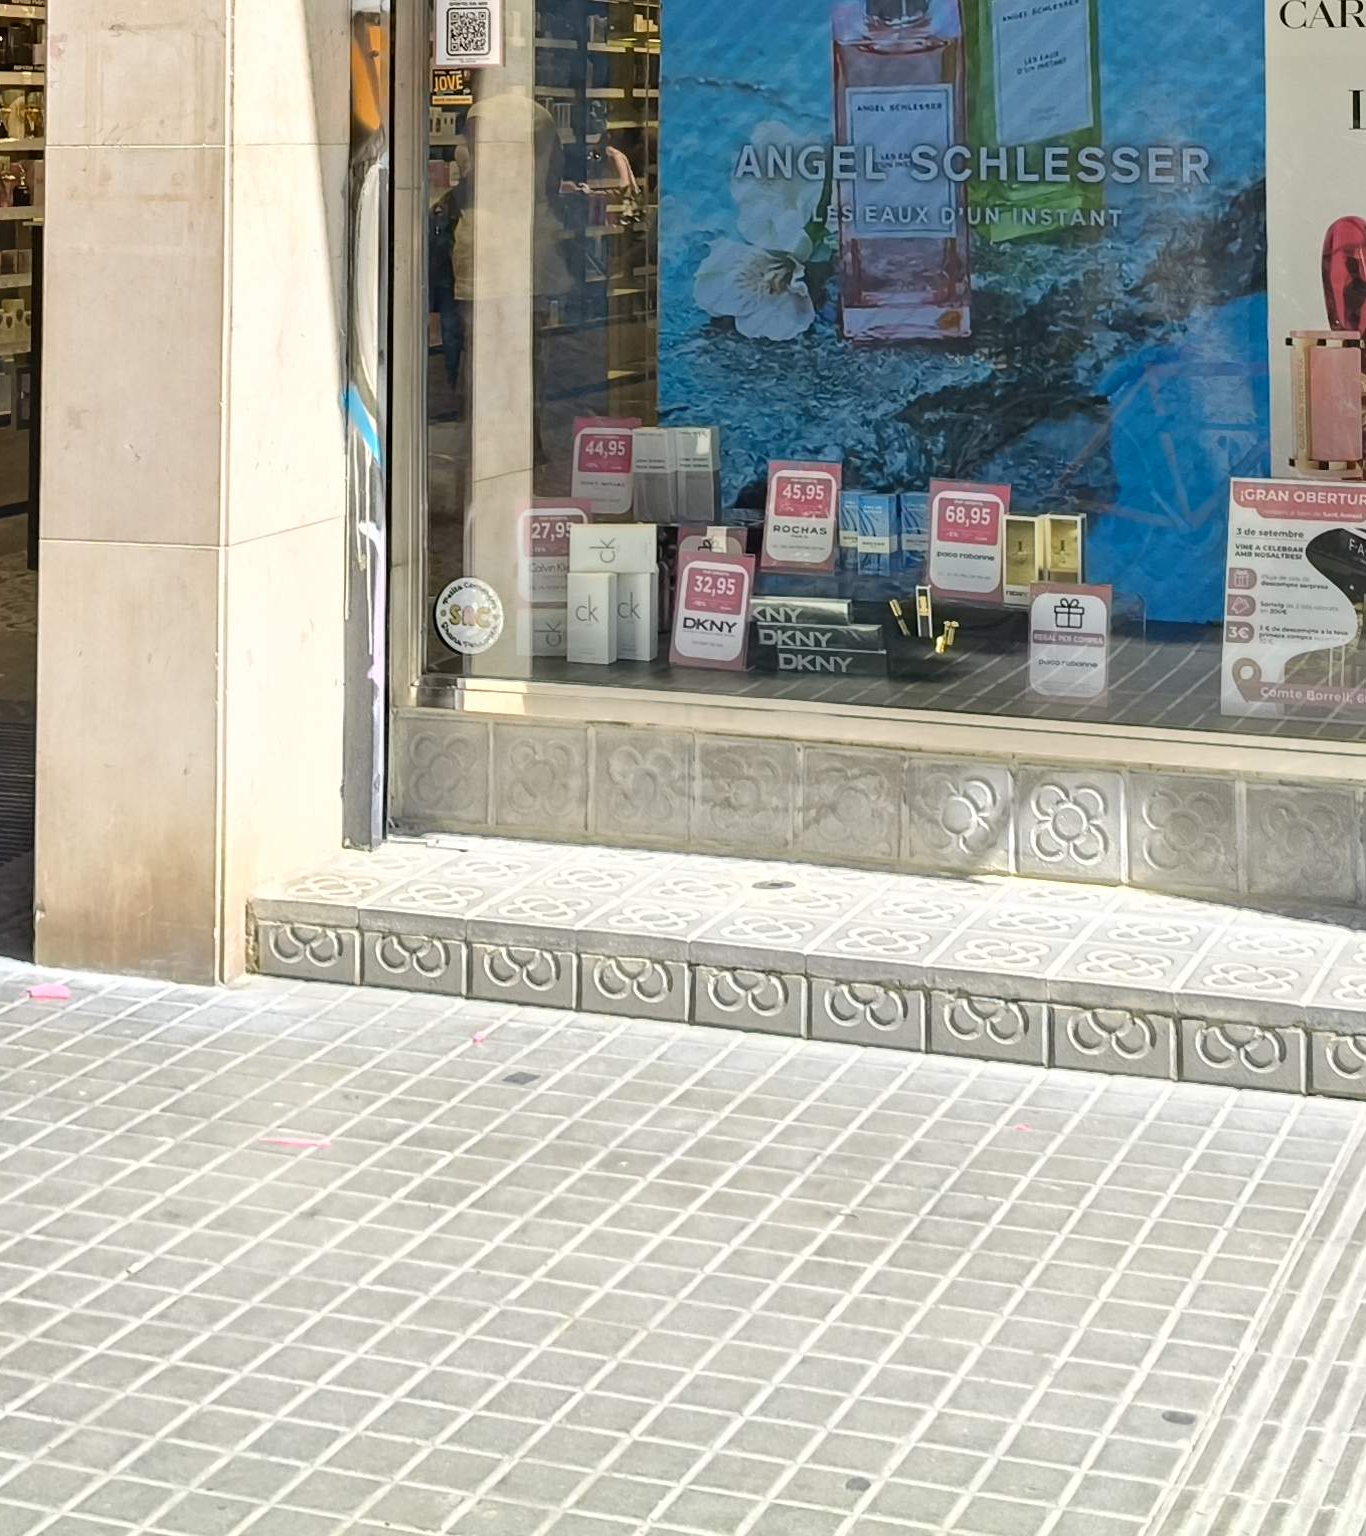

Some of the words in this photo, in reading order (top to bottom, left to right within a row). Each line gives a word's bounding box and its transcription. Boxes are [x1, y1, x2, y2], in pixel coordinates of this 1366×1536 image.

[857, 104, 885, 113] ANGEL
[889, 102, 942, 112] SCHLESSER
[734, 144, 886, 181] ANGEL
[910, 145, 1212, 184] SCHLESSER
[812, 205, 853, 222] LES
[864, 206, 928, 224] EAUX
[940, 207, 1000, 225] D'UN
[1011, 208, 1123, 228] INSTANT
[585, 440, 626, 457] 44,95
[783, 484, 825, 501] 45,95
[1240, 488, 1289, 502] ¡GRAN
[945, 505, 991, 527] 68,95
[773, 525, 828, 536] ROCHAS
[1236, 528, 1243, 536] 3
[1244, 528, 1256, 536] de
[1258, 529, 1304, 539] setembre
[588, 538, 616, 563] ck
[937, 551, 958, 559] paco
[959, 551, 995, 562] rabanne
[1234, 551, 1253, 559] AMB
[1262, 544, 1304, 553] CELEBRAR
[693, 575, 736, 597] 32,95
[575, 595, 599, 622] ck
[617, 592, 641, 619] ck
[683, 617, 737, 633] DKNY
[1227, 626, 1250, 639] 3€
[759, 629, 832, 647] DKNY
[779, 653, 853, 672] DKNY
[1260, 686, 1302, 700] Comte
